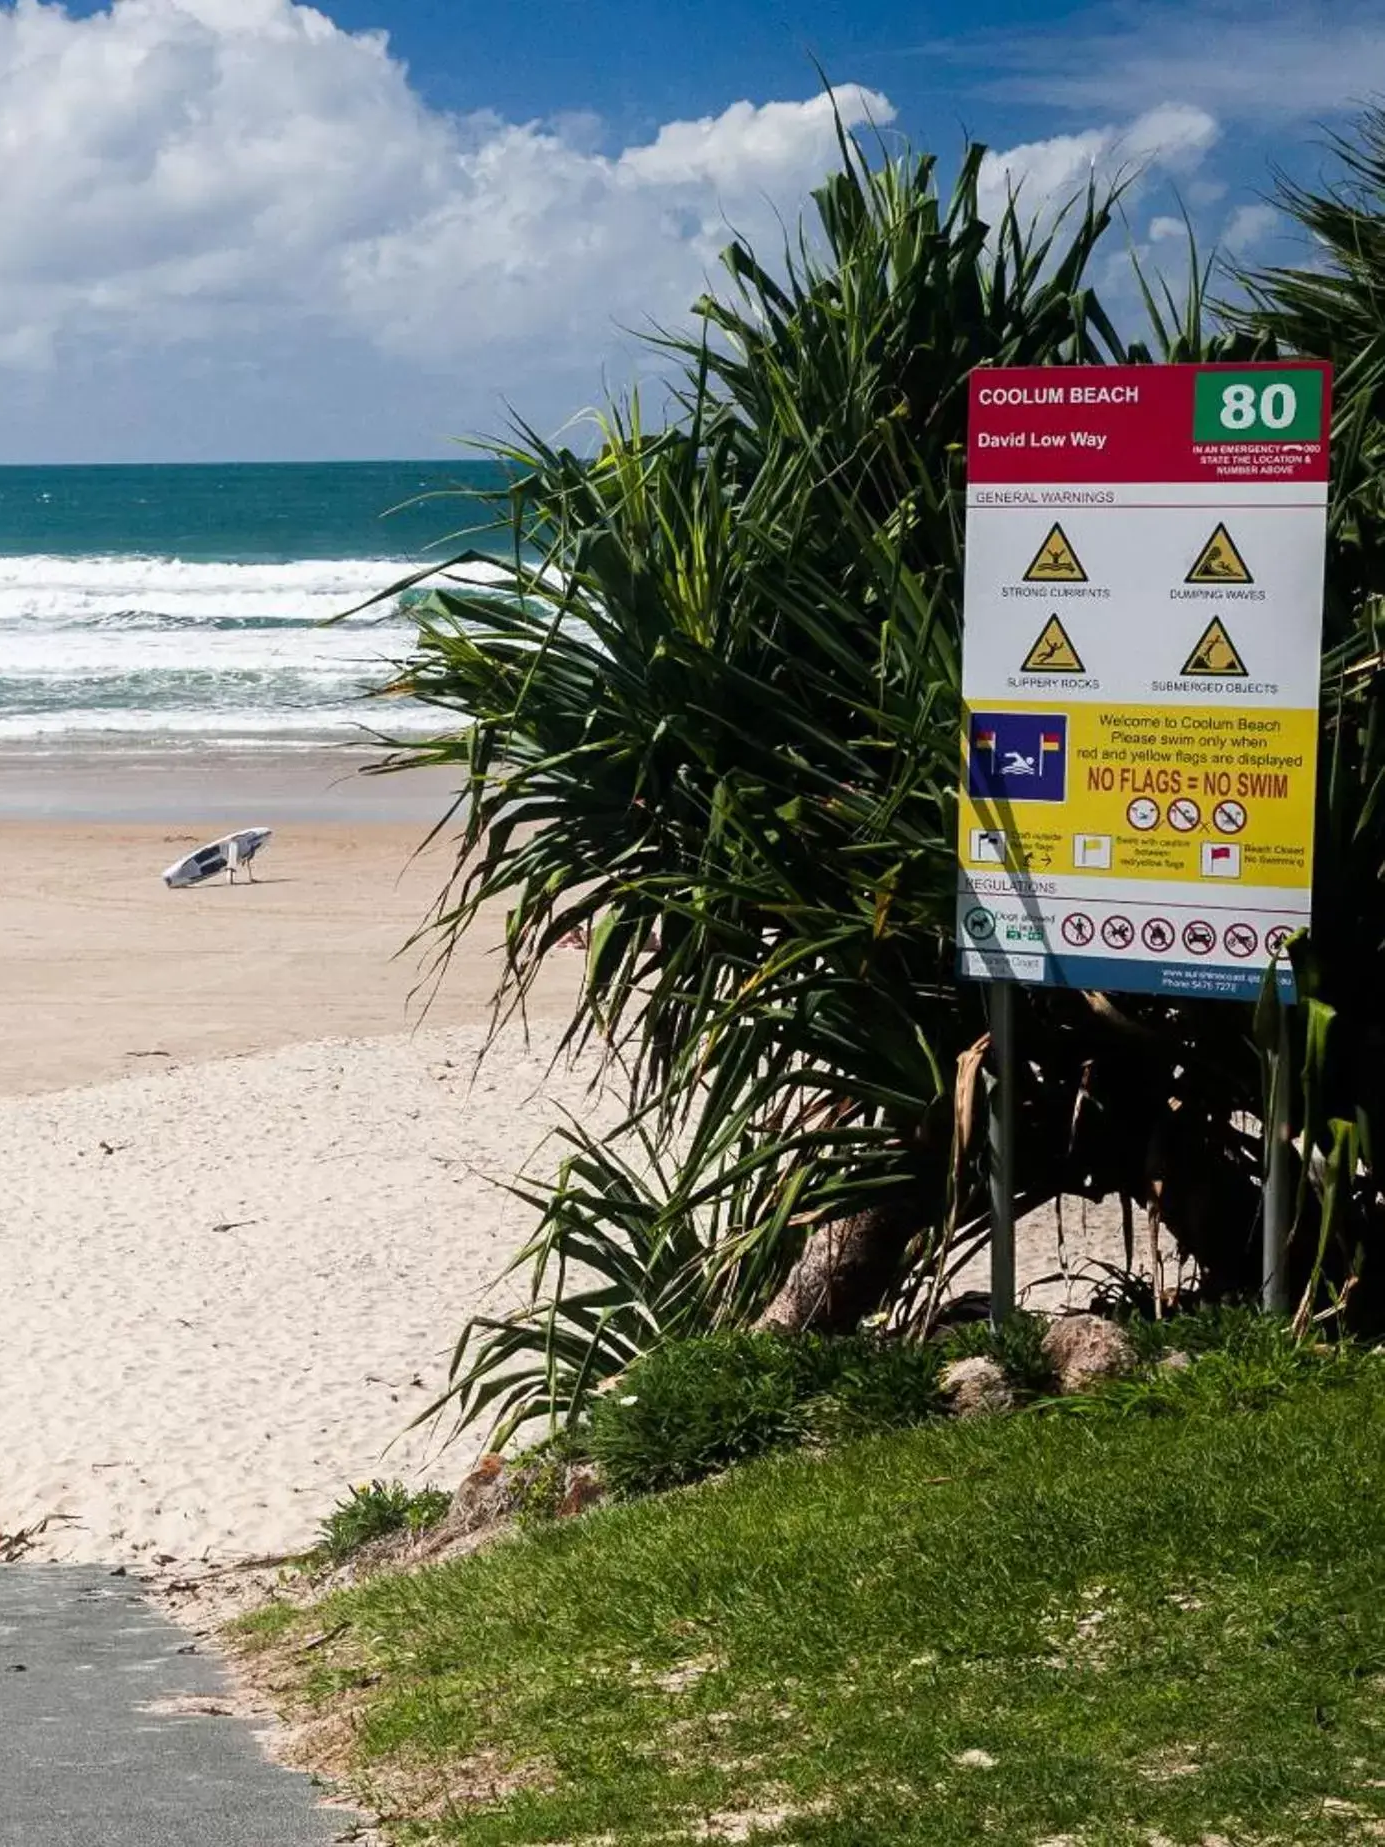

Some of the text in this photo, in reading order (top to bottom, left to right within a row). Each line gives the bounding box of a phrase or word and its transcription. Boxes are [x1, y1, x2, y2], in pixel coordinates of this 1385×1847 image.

[979, 386, 1139, 405] COOLUM BEACH
[1220, 383, 1297, 429] 80
[978, 432, 1107, 449] David Low Way
[1204, 445, 1218, 453] AN
[1220, 445, 1280, 453] EMERGENCY
[1200, 456, 1230, 464] STATE
[1232, 456, 1251, 464] THE
[1253, 456, 1302, 464] LOCATION
[1217, 466, 1294, 475] NUMBER ABOVE
[976, 491, 1115, 504] GENERAL WARNINGS
[1002, 587, 1111, 598] STRONG CURRENTS
[1170, 589, 1266, 600] DUMPING WAVES
[1008, 677, 1100, 689] SLIPPERY ROCKS
[1152, 681, 1278, 694] SUBMERGED OBJECTS
[1100, 715, 1281, 731] Welcome to Coolum Beach
[1111, 731, 1267, 749] Please swim only when
[1077, 748, 1303, 768] red and yellow flags are displayed
[1087, 767, 1288, 798] NO FLAGS = NO SWIM
[965, 878, 1058, 894] REGULATIONS
